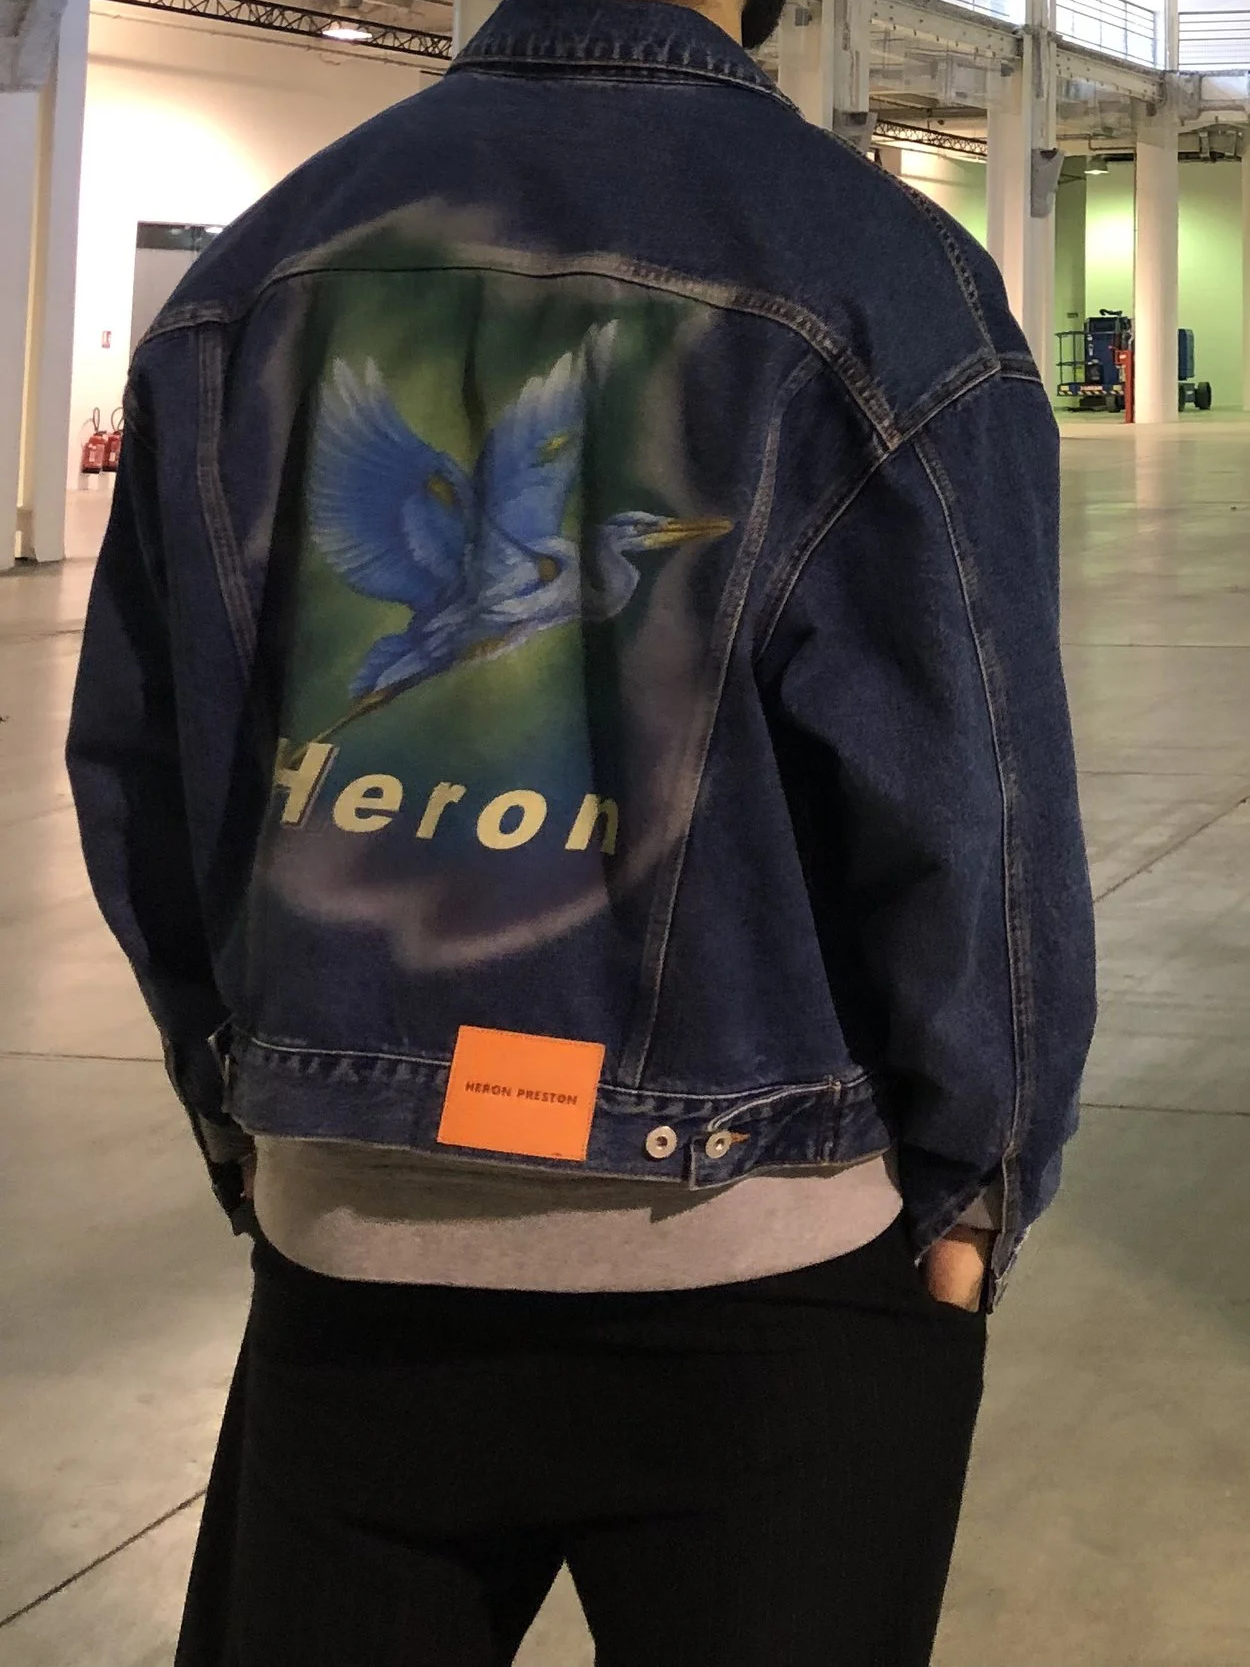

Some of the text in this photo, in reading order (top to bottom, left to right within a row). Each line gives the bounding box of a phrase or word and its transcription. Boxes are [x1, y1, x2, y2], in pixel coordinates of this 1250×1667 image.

[273, 737, 618, 855] Heron
[465, 1081, 577, 1105] HERON PRESTON
